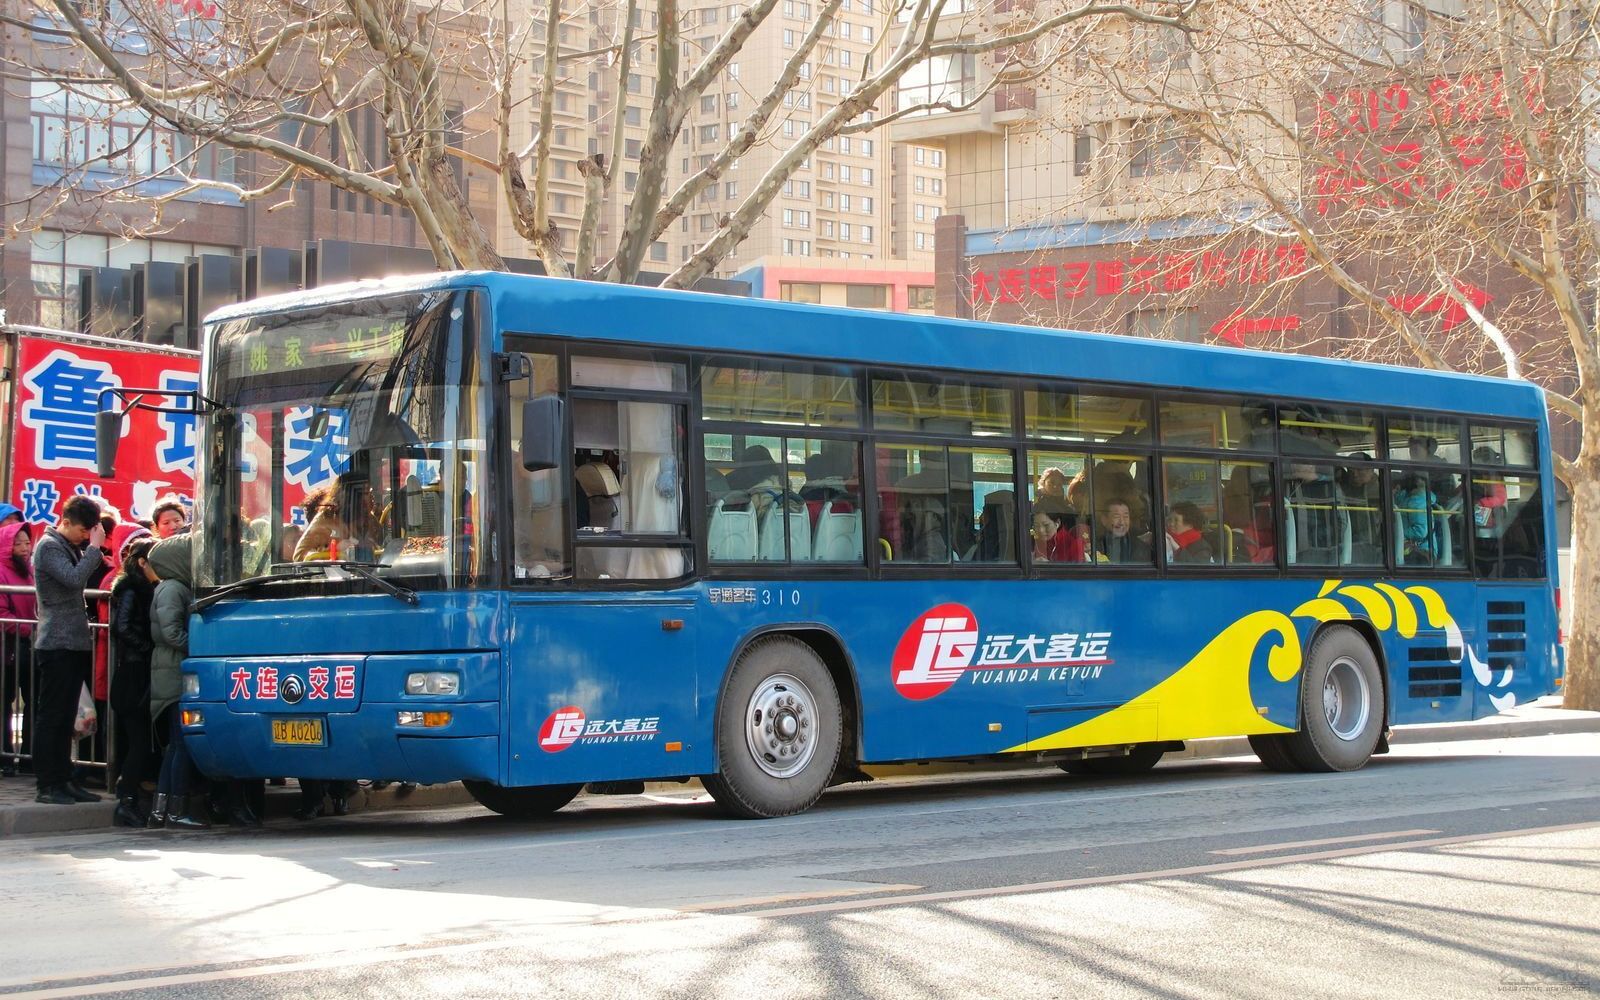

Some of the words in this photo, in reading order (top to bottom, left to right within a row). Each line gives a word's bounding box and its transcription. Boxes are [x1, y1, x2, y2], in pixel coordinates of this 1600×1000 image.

[249, 336, 304, 372] 姚家
[709, 587, 757, 603] 宇通客车
[762, 589, 800, 606] 310
[977, 631, 1112, 666] 远大客运
[230, 666, 278, 700] 大连
[308, 665, 356, 699] 交运
[970, 668, 1039, 685] YUANDA
[1047, 665, 1103, 682] KEYUN
[584, 716, 660, 736] 远大客运
[581, 735, 619, 745] YUANDA
[623, 733, 655, 742] KEYUN
